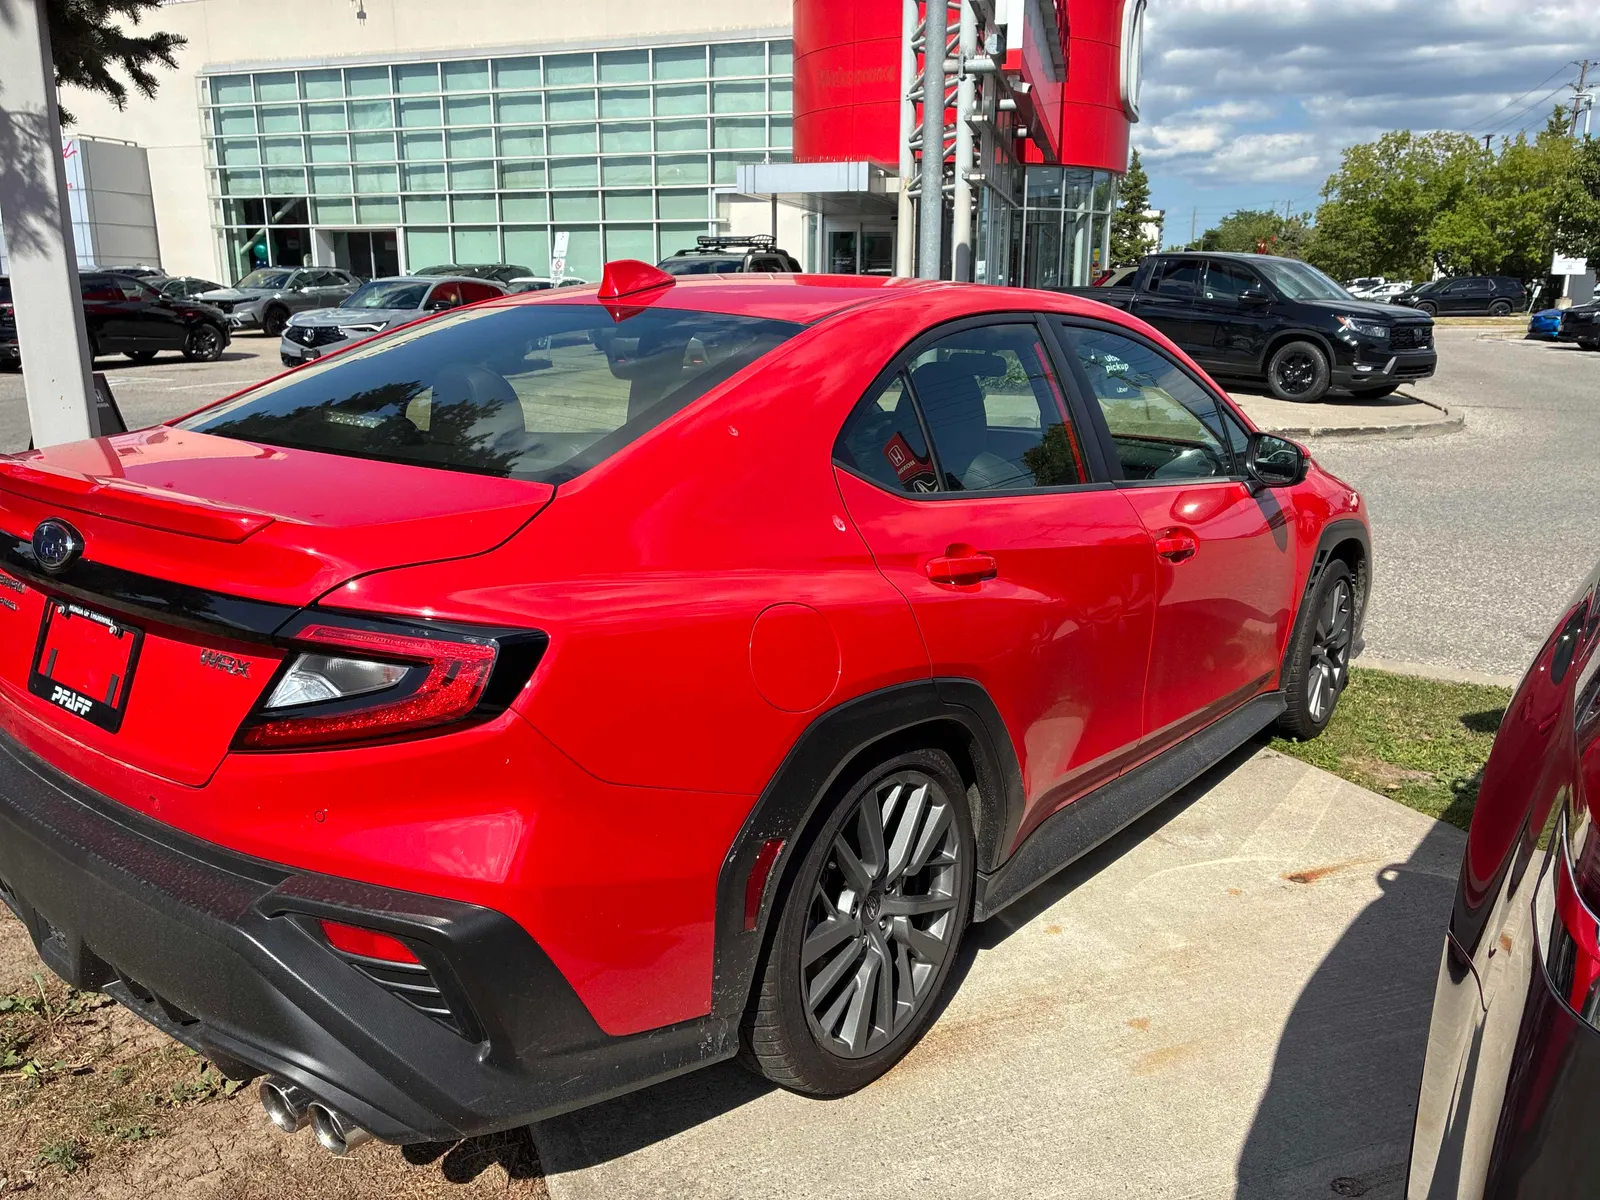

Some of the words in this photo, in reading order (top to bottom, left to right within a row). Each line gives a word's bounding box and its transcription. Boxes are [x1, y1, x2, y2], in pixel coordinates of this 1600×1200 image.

[1105, 361, 1129, 374] pickup
[200, 648, 252, 680] WRX
[51, 685, 93, 716] PFAFF
